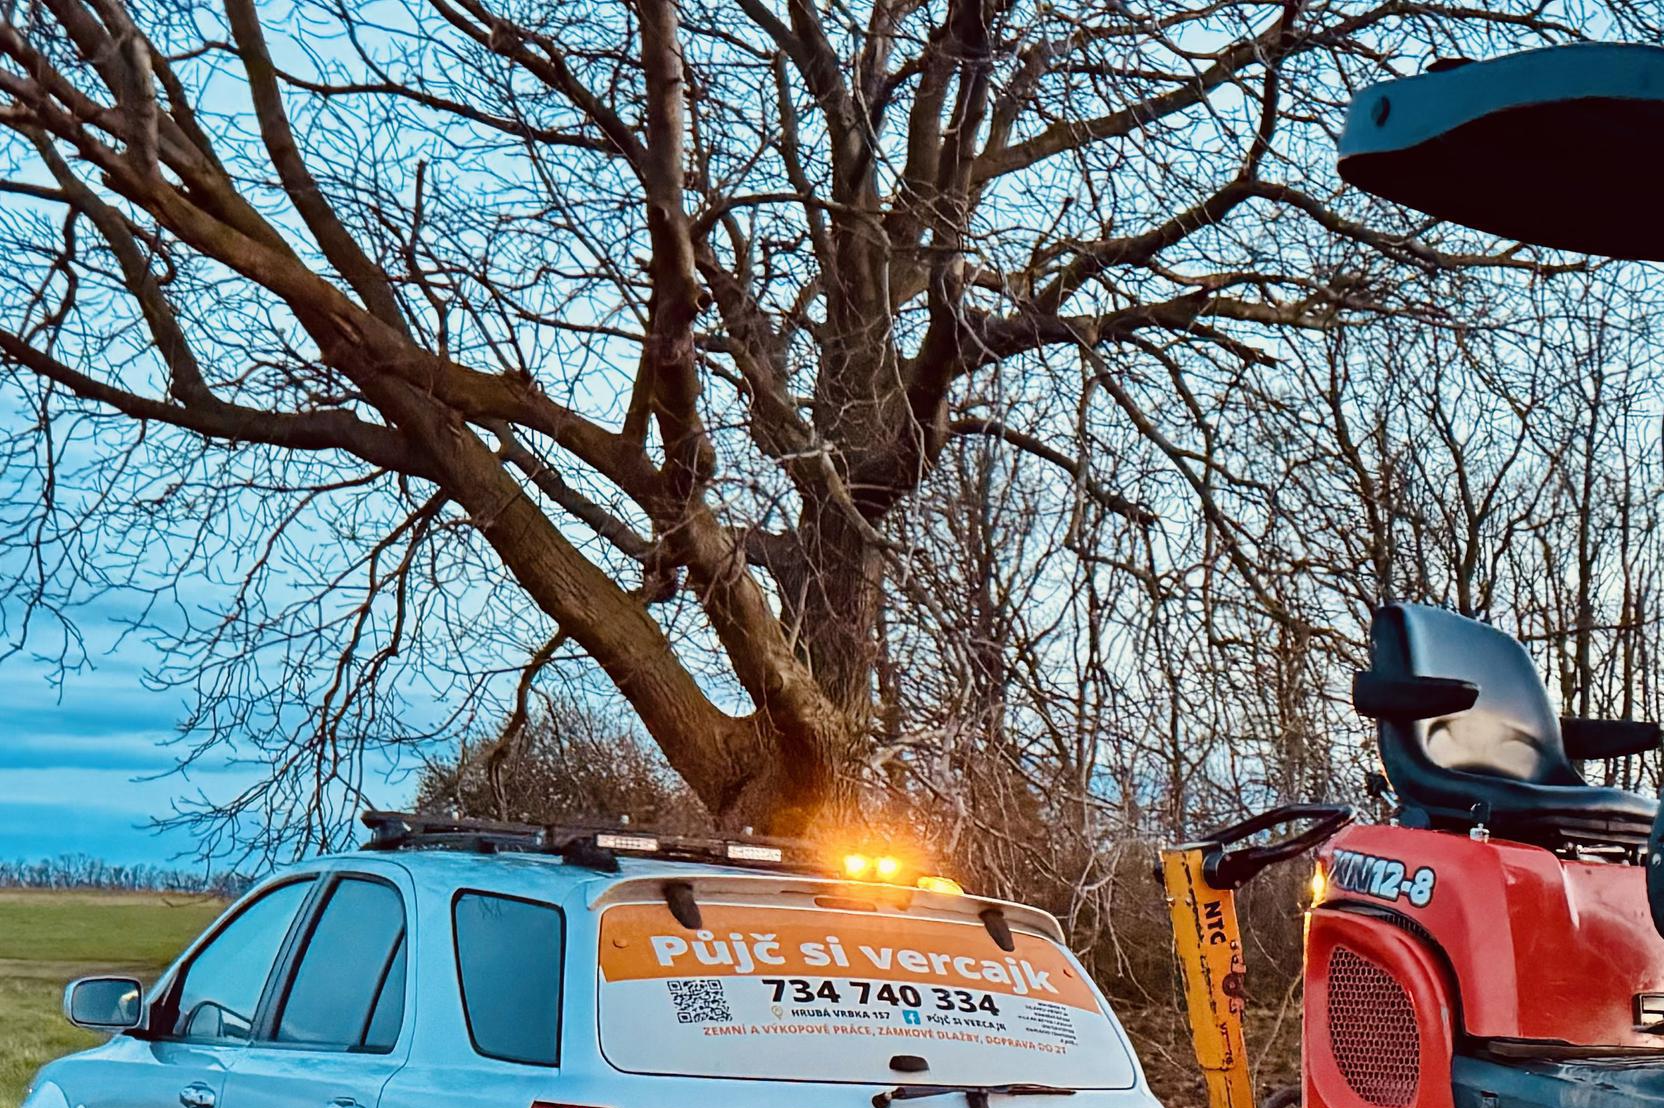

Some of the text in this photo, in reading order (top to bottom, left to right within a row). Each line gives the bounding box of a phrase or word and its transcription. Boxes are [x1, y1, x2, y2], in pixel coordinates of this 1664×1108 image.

[650, 930, 1059, 995] Půjč si vercajk
[762, 979, 1000, 1016] 734 740 334
[791, 1008, 830, 1018] HRUBÁ
[874, 1011, 890, 1020] 157
[703, 1023, 747, 1036] ZEMNÍ
[751, 1025, 760, 1035] A
[763, 1023, 830, 1035] VÝKOPOVÉ
